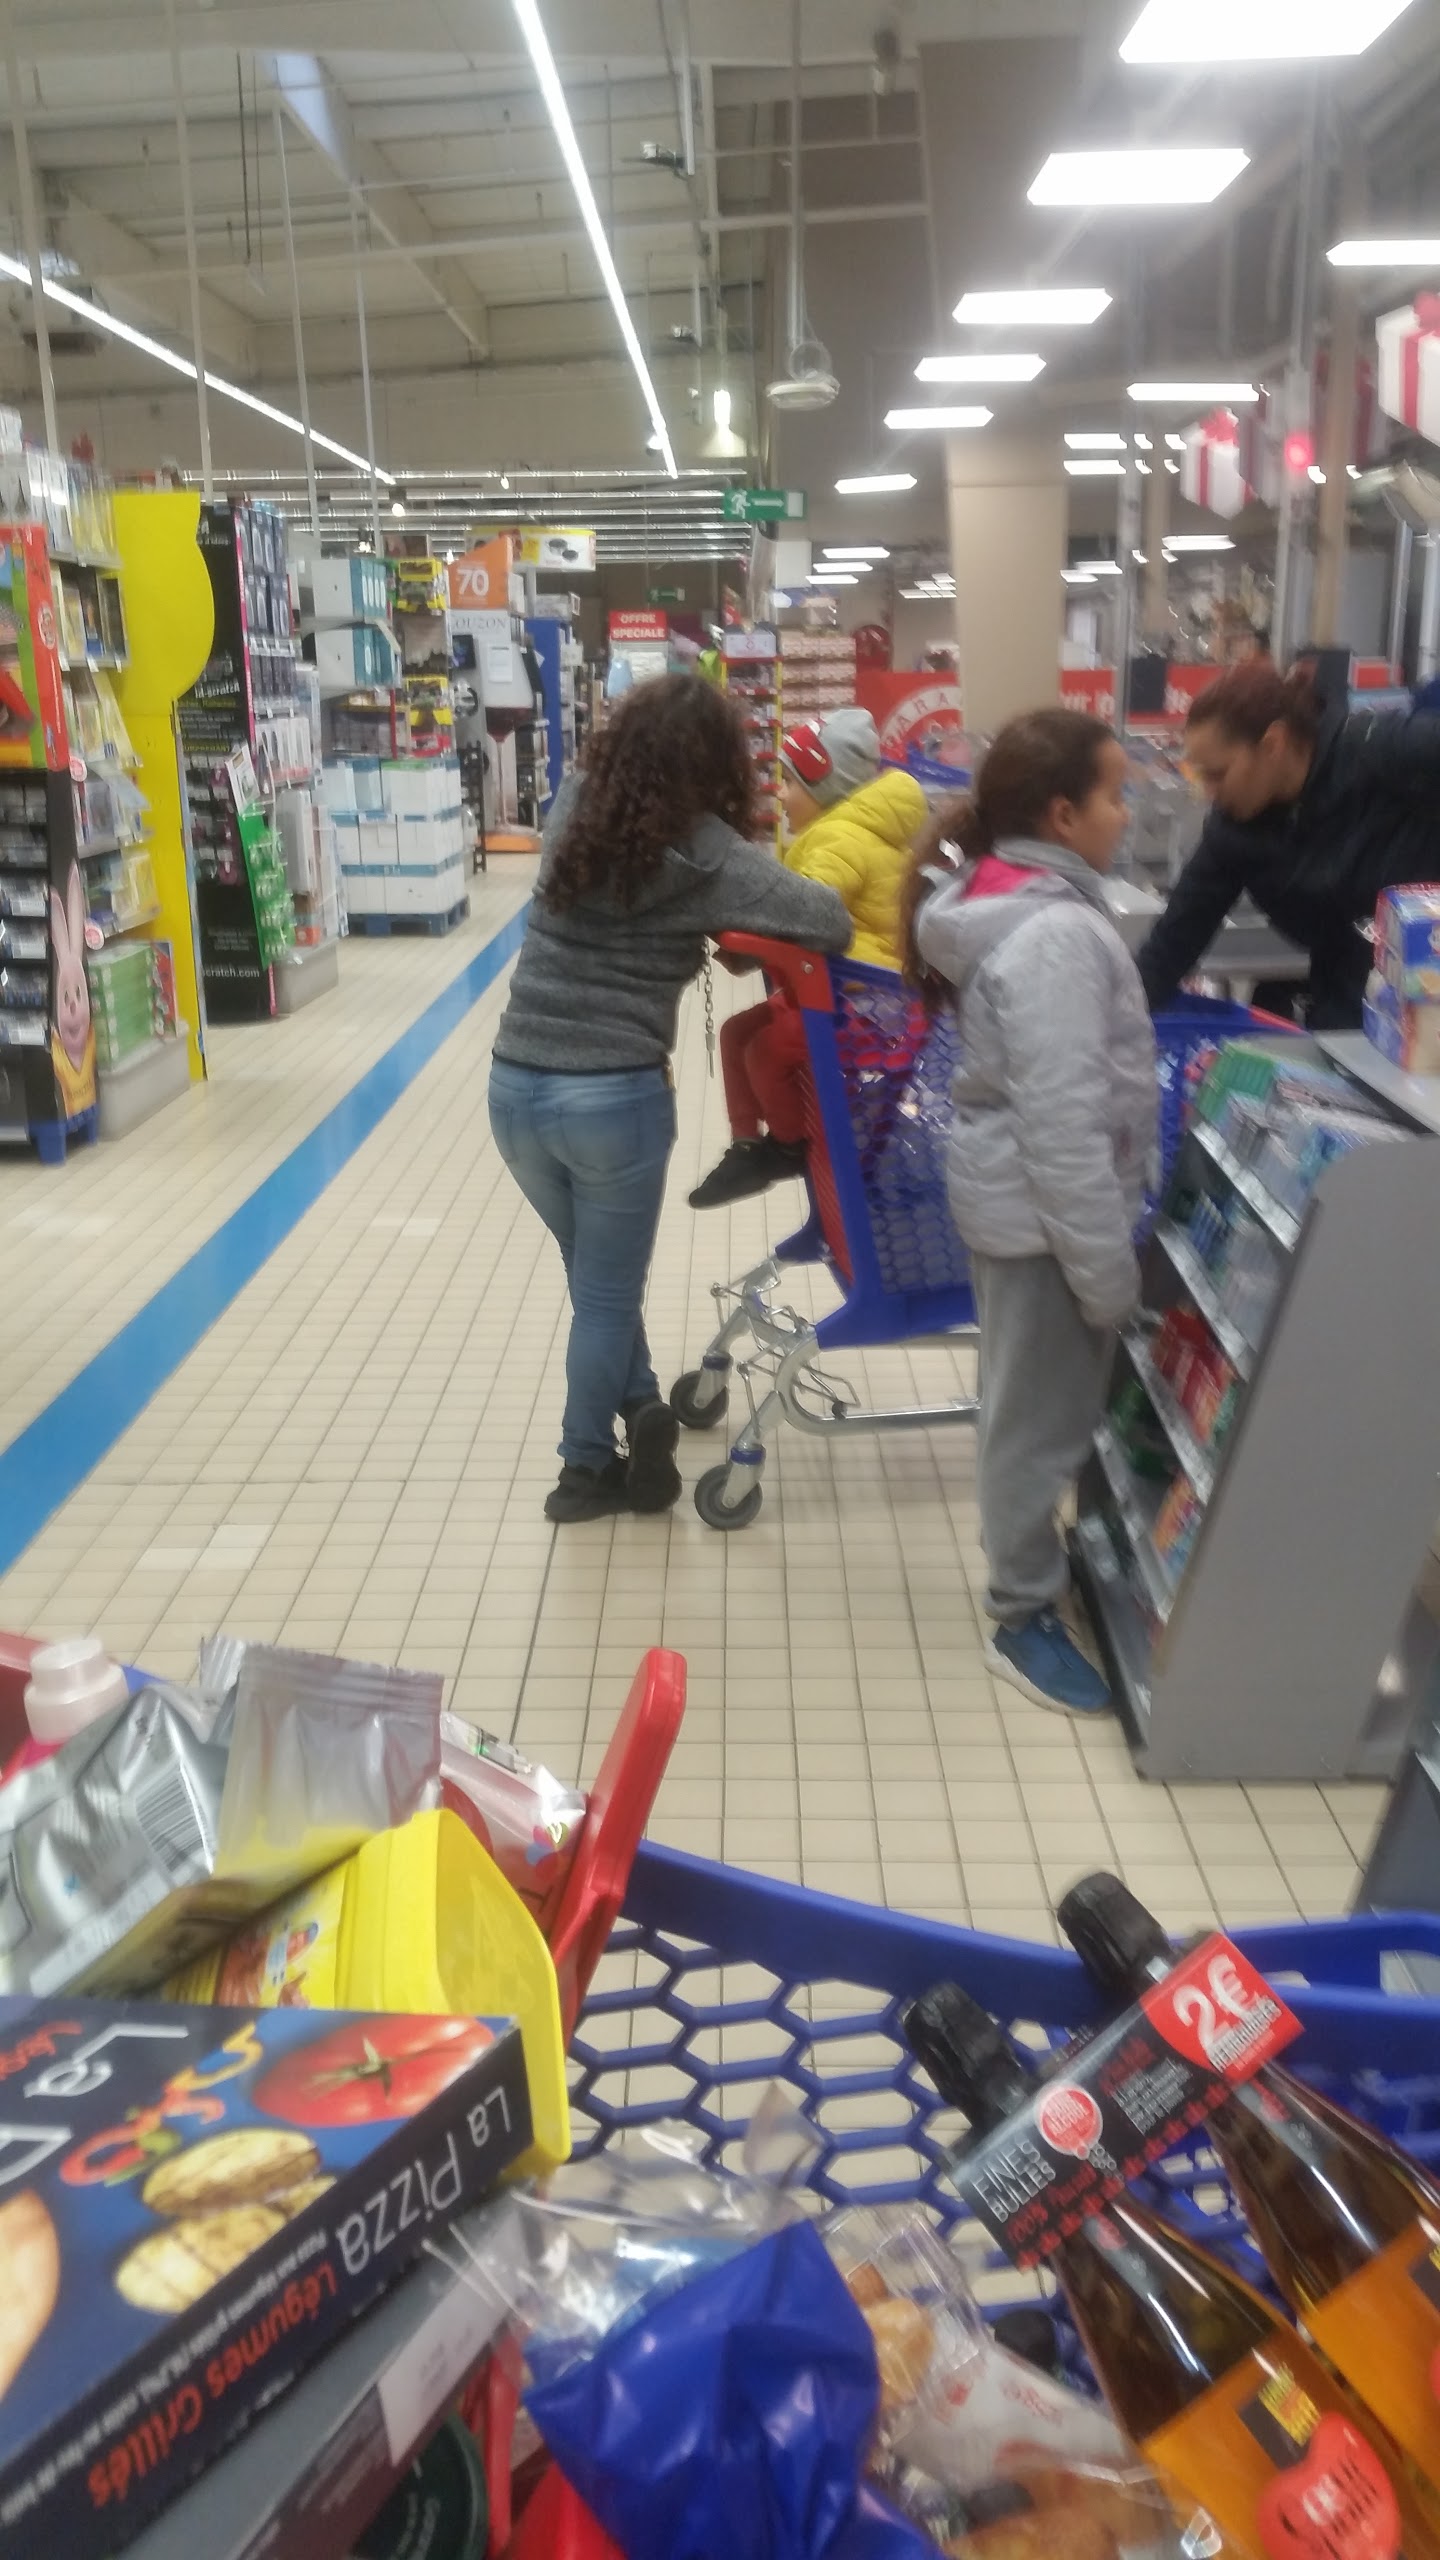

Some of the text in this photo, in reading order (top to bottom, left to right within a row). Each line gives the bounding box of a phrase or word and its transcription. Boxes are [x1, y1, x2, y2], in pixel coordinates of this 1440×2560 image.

[456, 567, 490, 597] 70
[620, 614, 656, 624] OFFRE
[336, 2085, 512, 2276] La Pizza
[972, 2136, 1041, 2201] FINES
[988, 2160, 1056, 2223] BULLES
[206, 2261, 337, 2398] Légumes
[88, 2383, 202, 2508] Grillés
